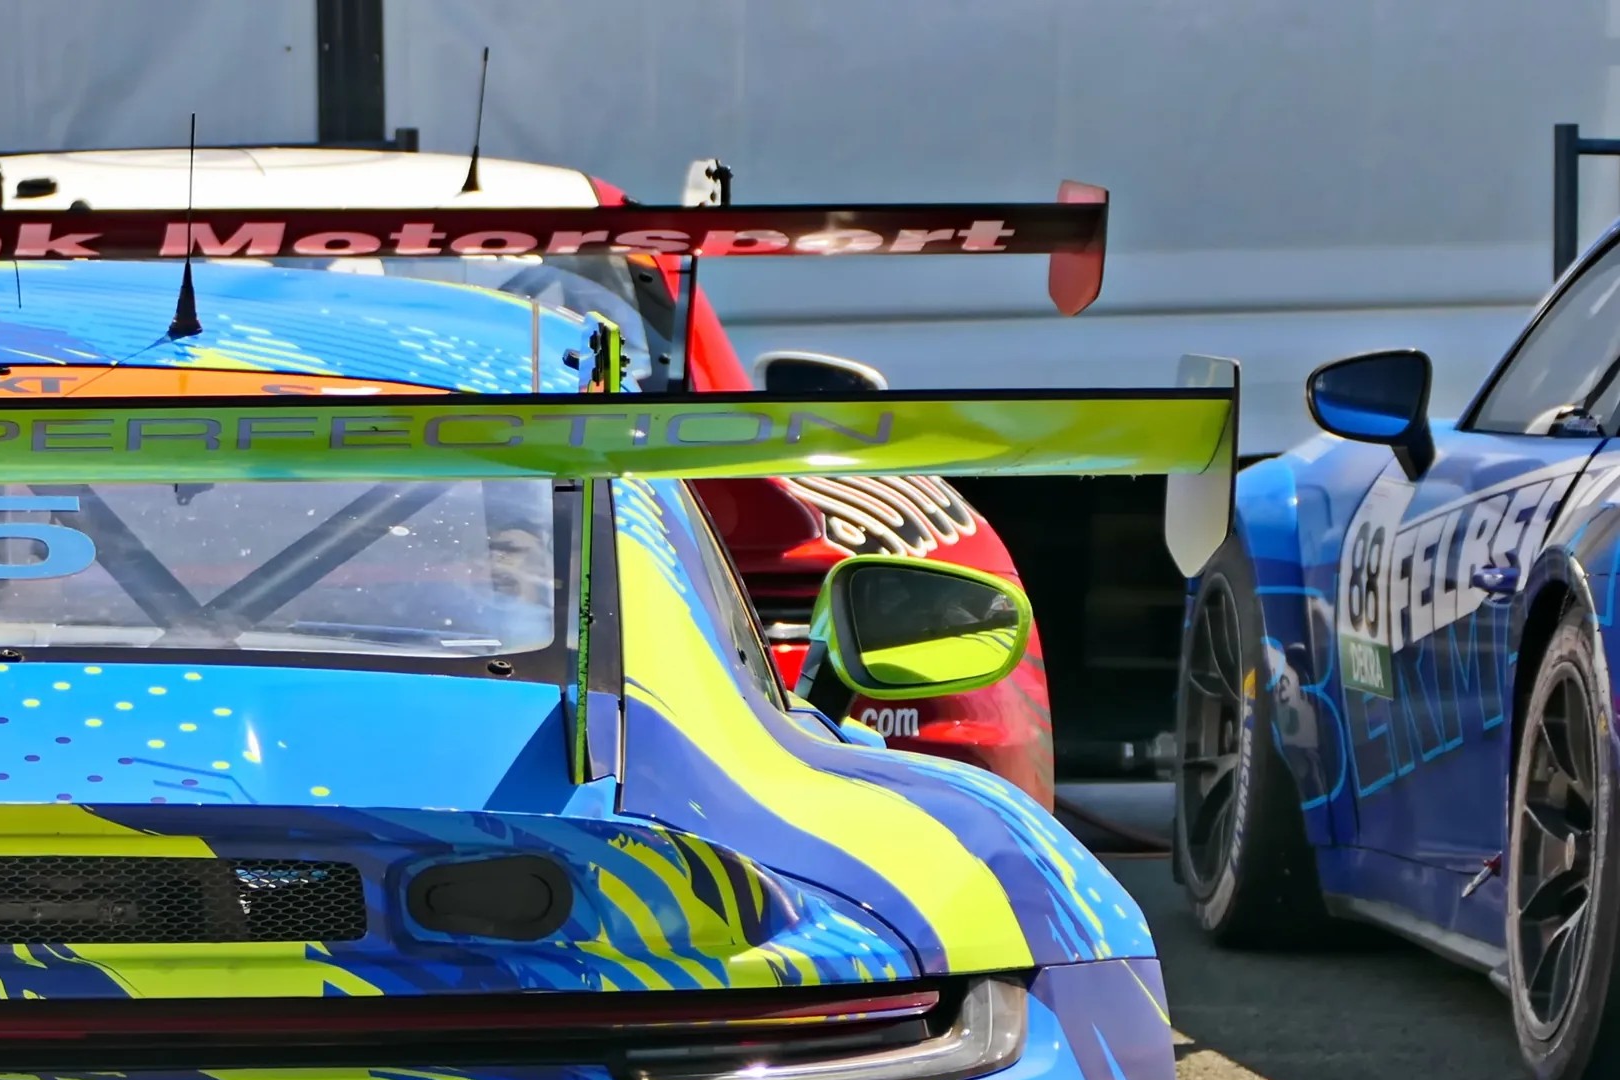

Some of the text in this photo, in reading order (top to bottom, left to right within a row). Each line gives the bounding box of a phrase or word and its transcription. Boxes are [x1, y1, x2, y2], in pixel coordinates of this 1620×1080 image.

[160, 219, 1017, 257] Motorsport
[1348, 521, 1386, 639] 88
[1350, 641, 1385, 690] DEKRA
